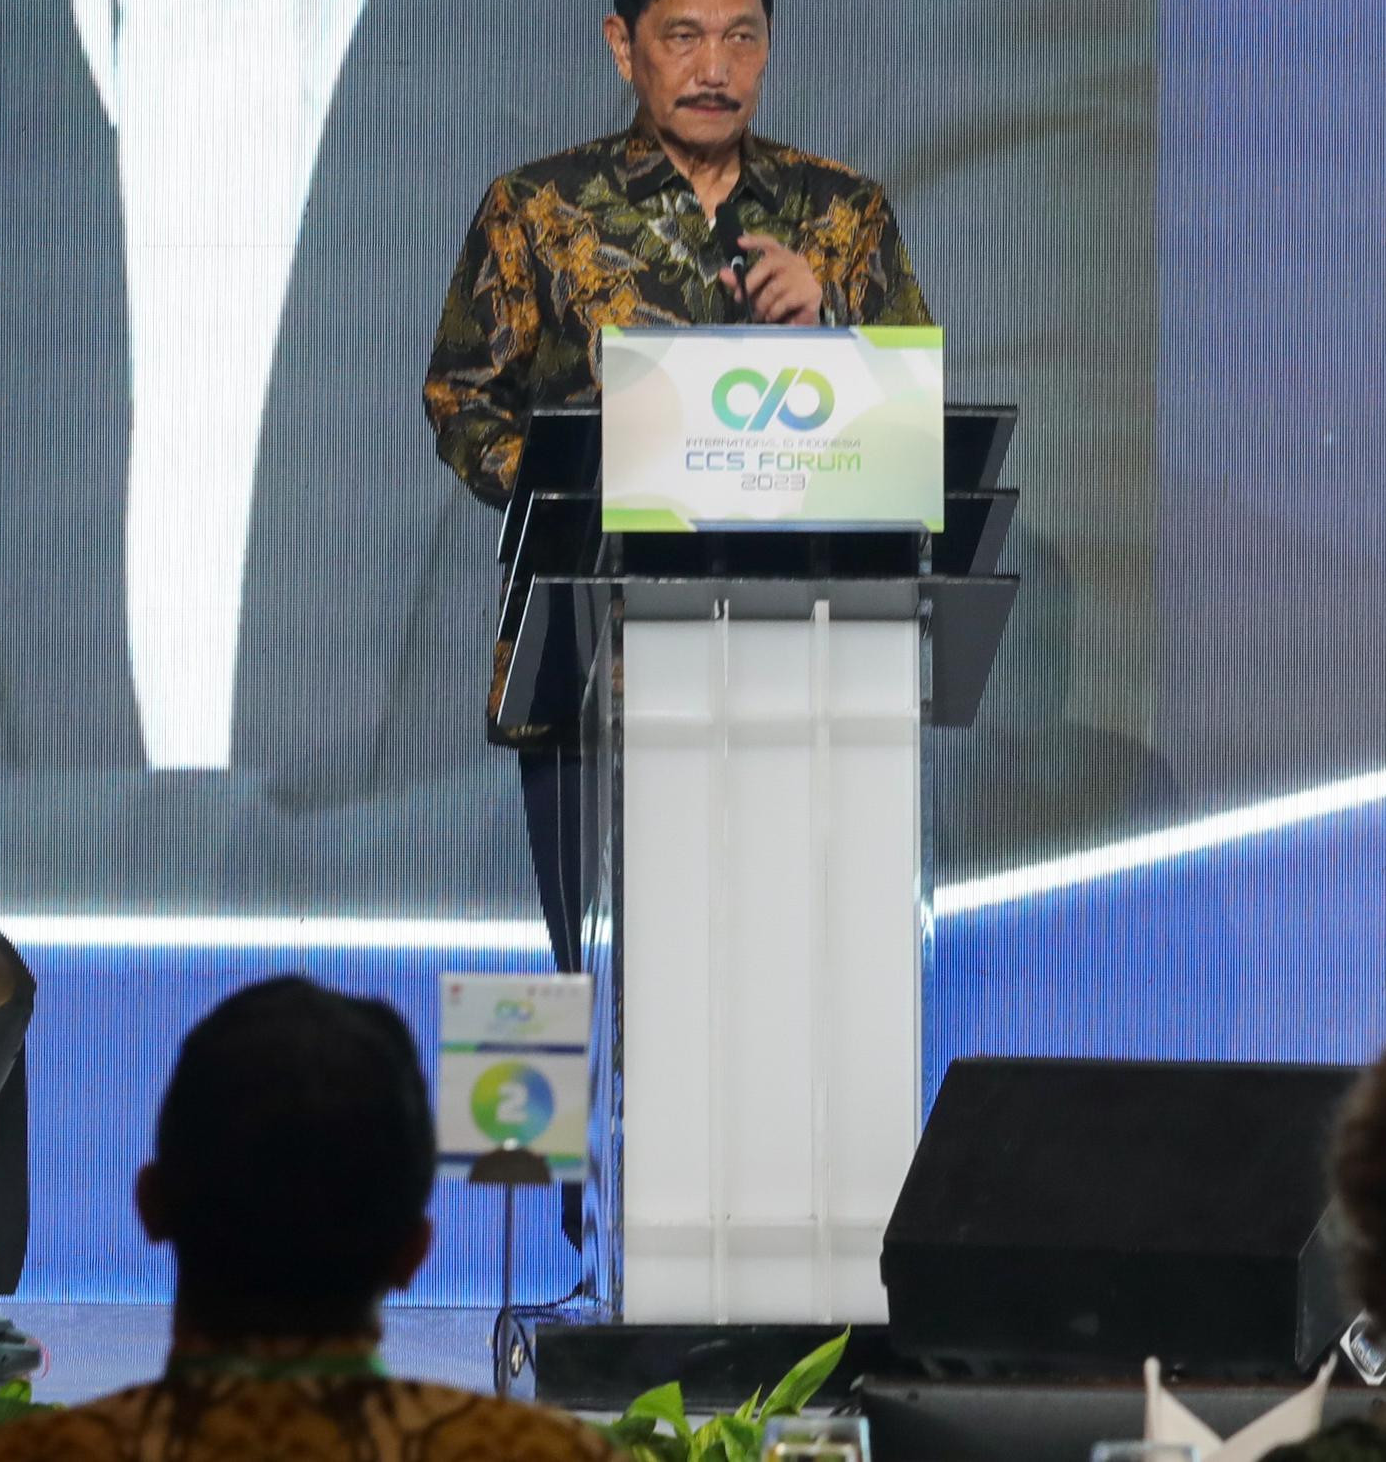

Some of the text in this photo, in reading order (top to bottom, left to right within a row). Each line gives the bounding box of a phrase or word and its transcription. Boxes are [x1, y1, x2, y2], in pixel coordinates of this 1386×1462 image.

[685, 452, 862, 472] CCS FORUM
[740, 474, 807, 491] 2023
[495, 1080, 530, 1126] 2
